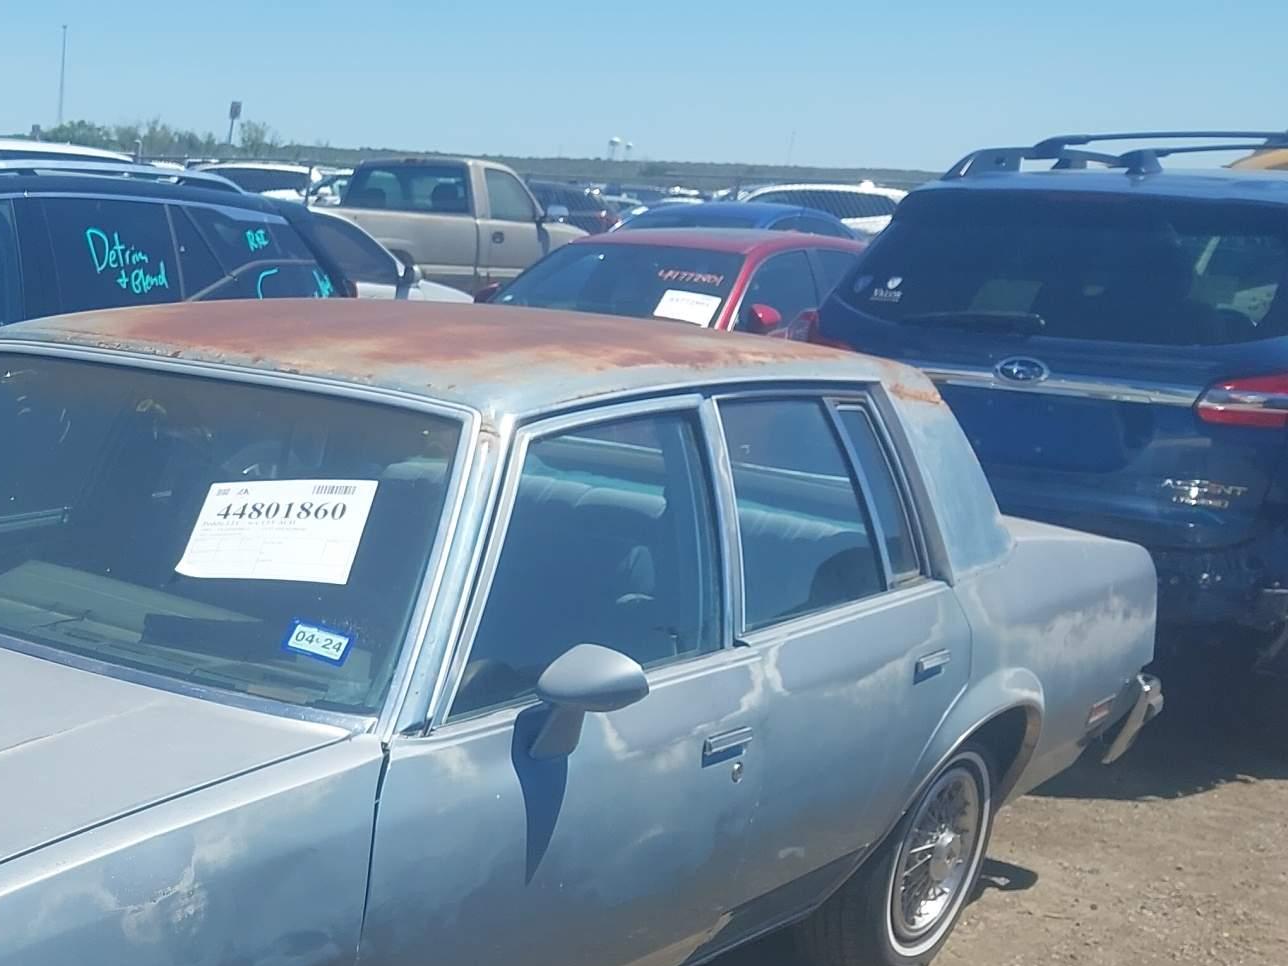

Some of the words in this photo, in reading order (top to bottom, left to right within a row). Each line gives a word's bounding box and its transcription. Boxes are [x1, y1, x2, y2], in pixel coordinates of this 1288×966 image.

[217, 503, 346, 520] 44801860
[295, 631, 316, 645] 04
[321, 638, 343, 653] 24
